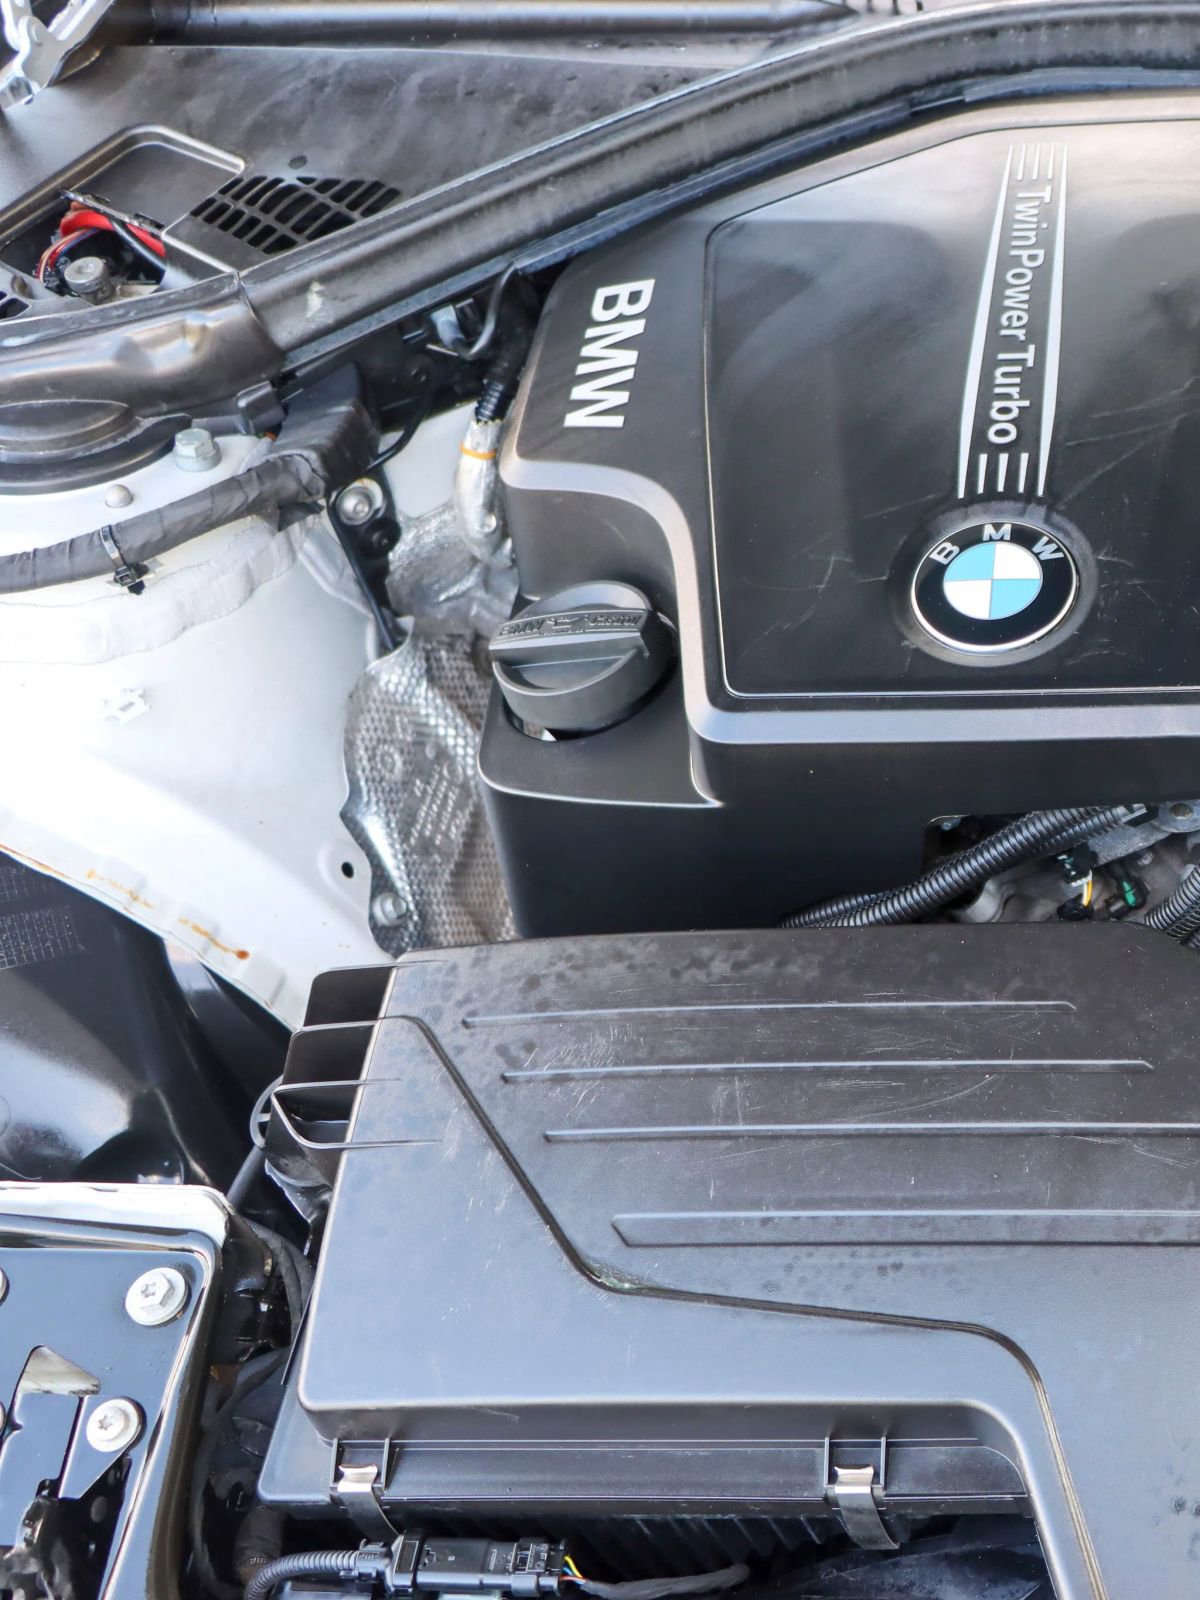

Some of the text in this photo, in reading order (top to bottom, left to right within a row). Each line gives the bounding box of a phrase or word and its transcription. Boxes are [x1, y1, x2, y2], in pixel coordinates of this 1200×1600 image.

[563, 278, 656, 428] BMW
[987, 185, 1052, 445] TwinPower Turbo
[929, 523, 1065, 566] BMW
